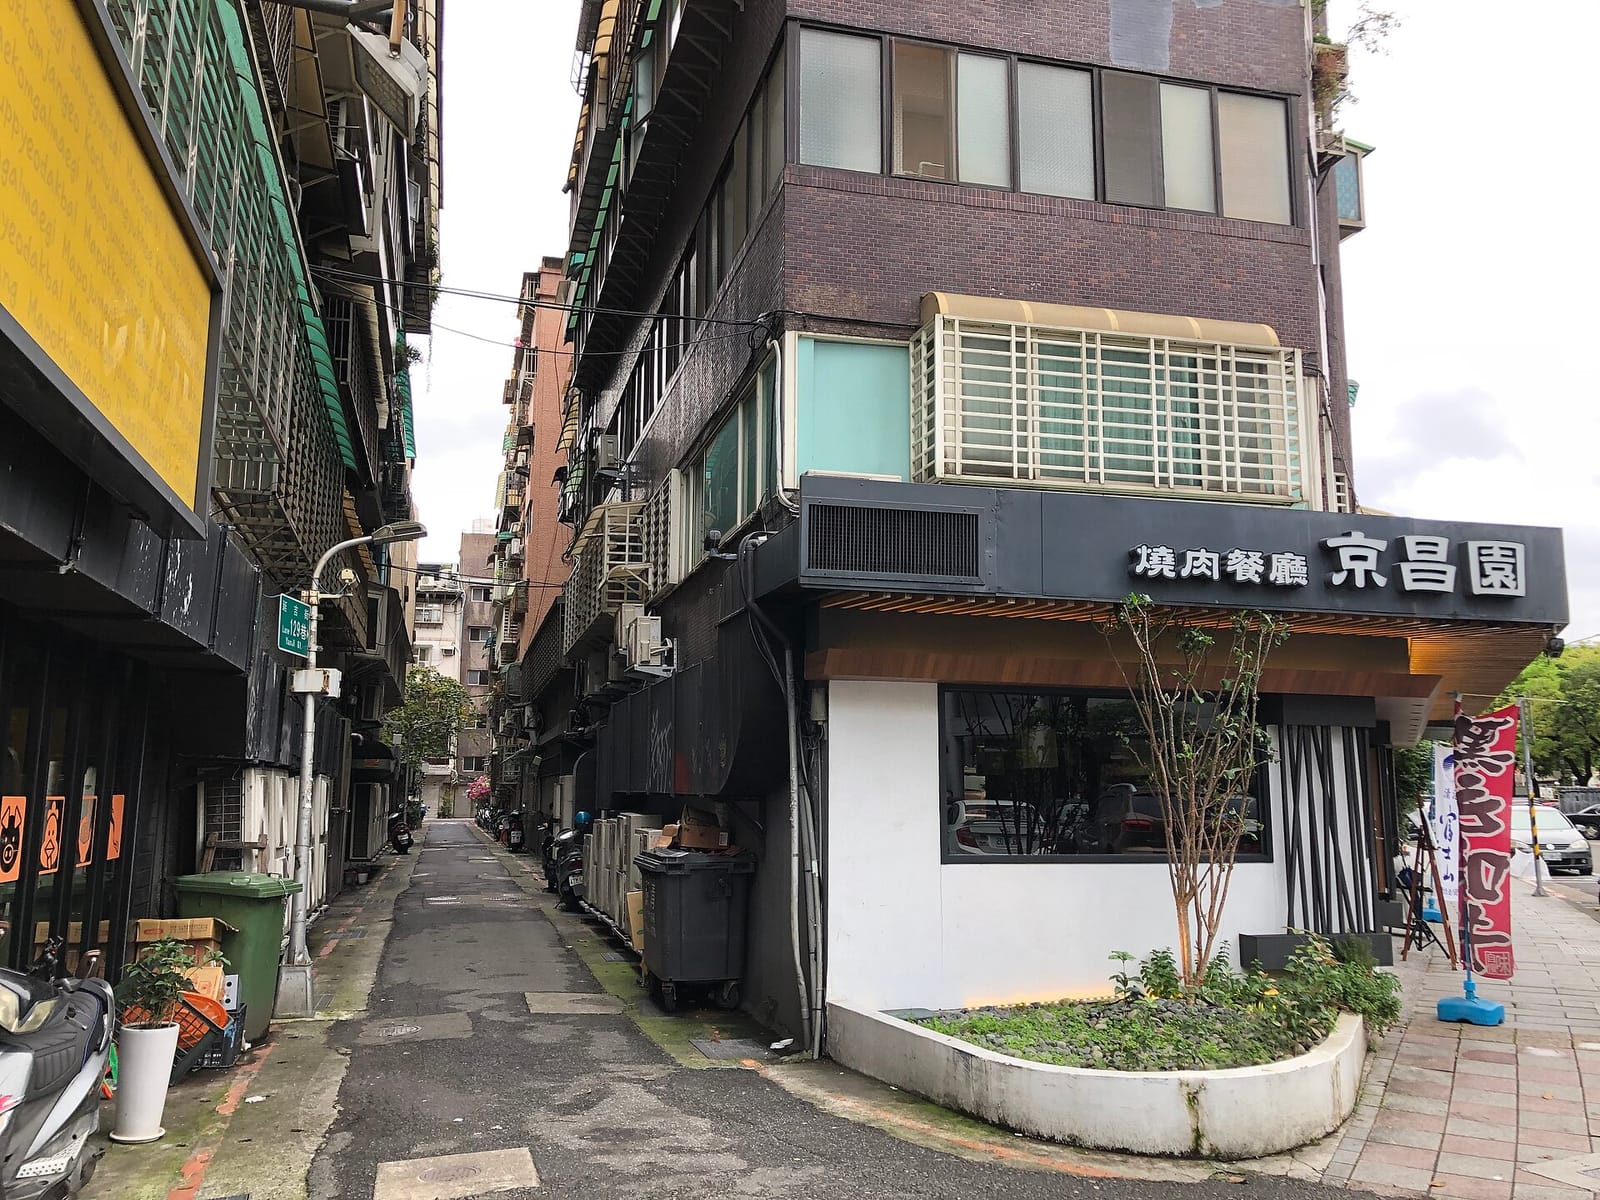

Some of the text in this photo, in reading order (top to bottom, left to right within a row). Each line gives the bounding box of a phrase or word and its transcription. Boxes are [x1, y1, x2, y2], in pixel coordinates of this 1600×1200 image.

[1132, 531, 1527, 598] 燒肉餐廳 京昌園
